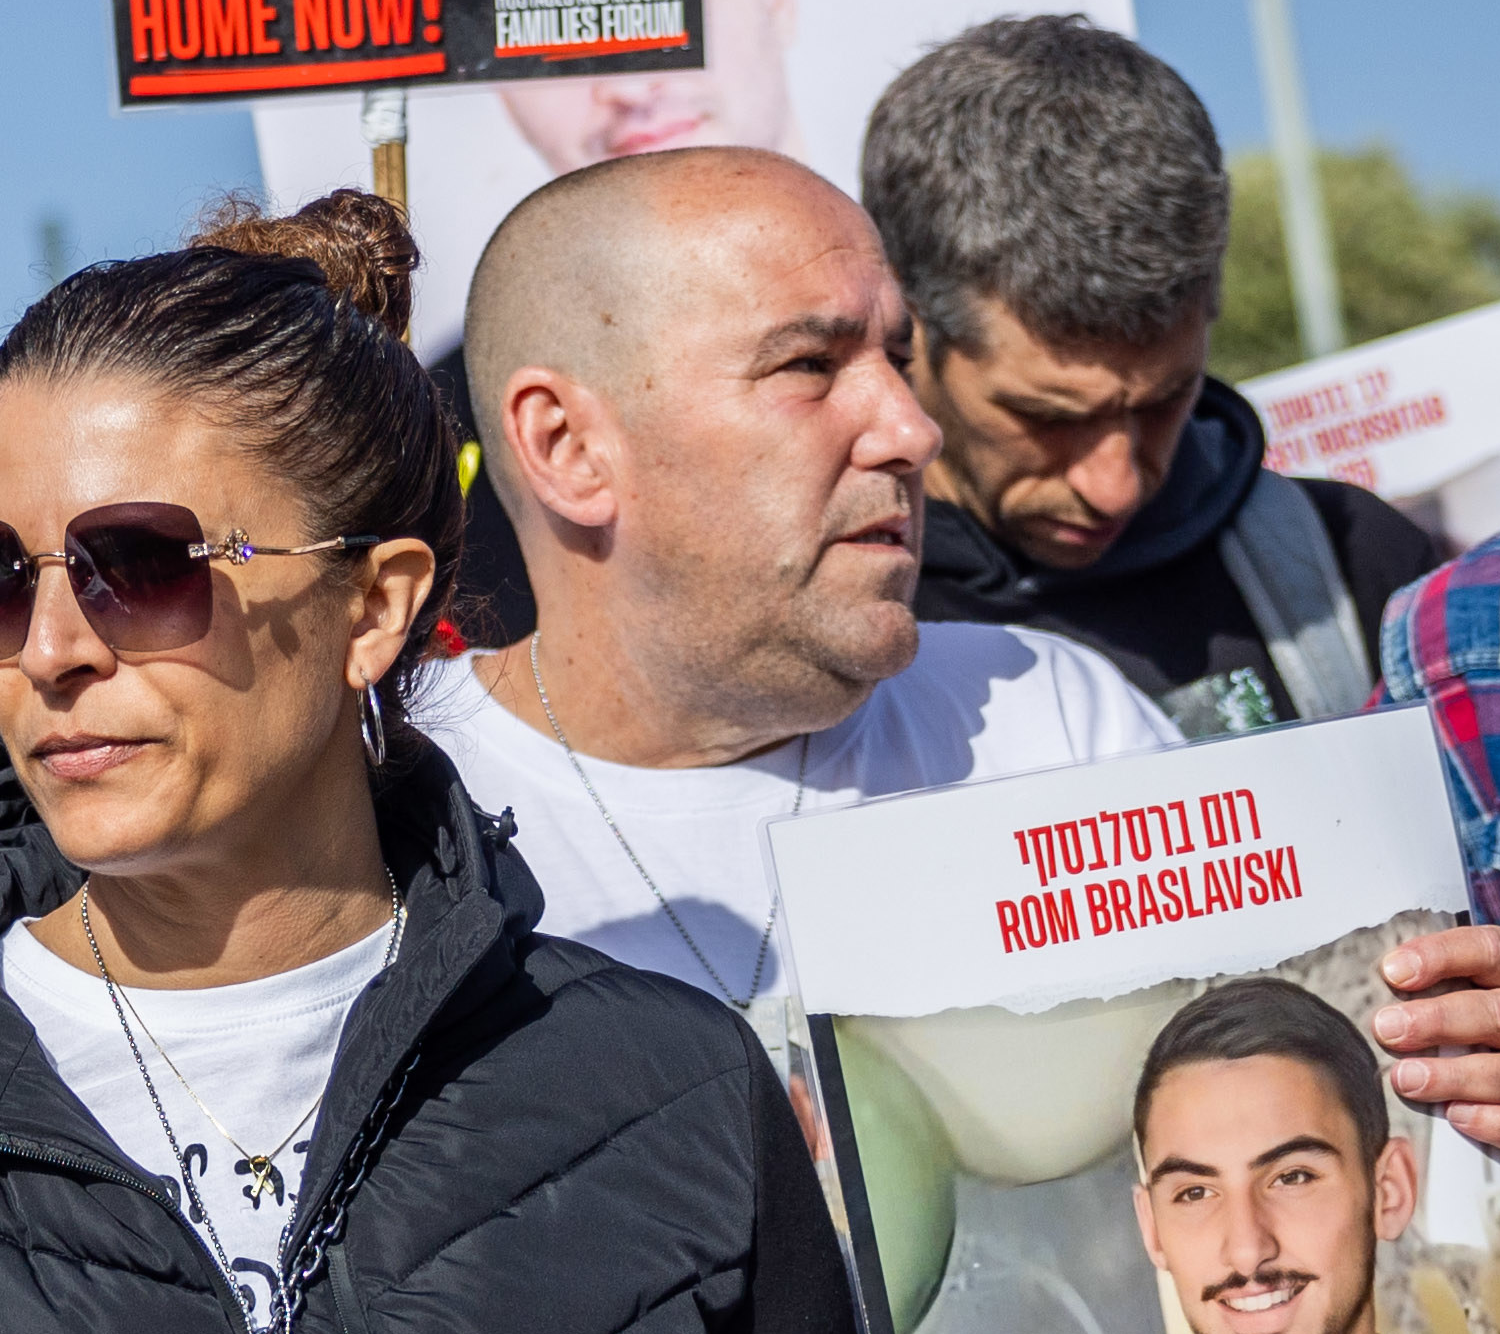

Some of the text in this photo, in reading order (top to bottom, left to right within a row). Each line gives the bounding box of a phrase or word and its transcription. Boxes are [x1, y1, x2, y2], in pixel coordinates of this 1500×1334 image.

[496, 1, 683, 49] FAMILIES FORUM
[1014, 788, 1262, 887] רום ברסלבסקי
[995, 846, 1303, 954] ROM BRASLAVSKI
